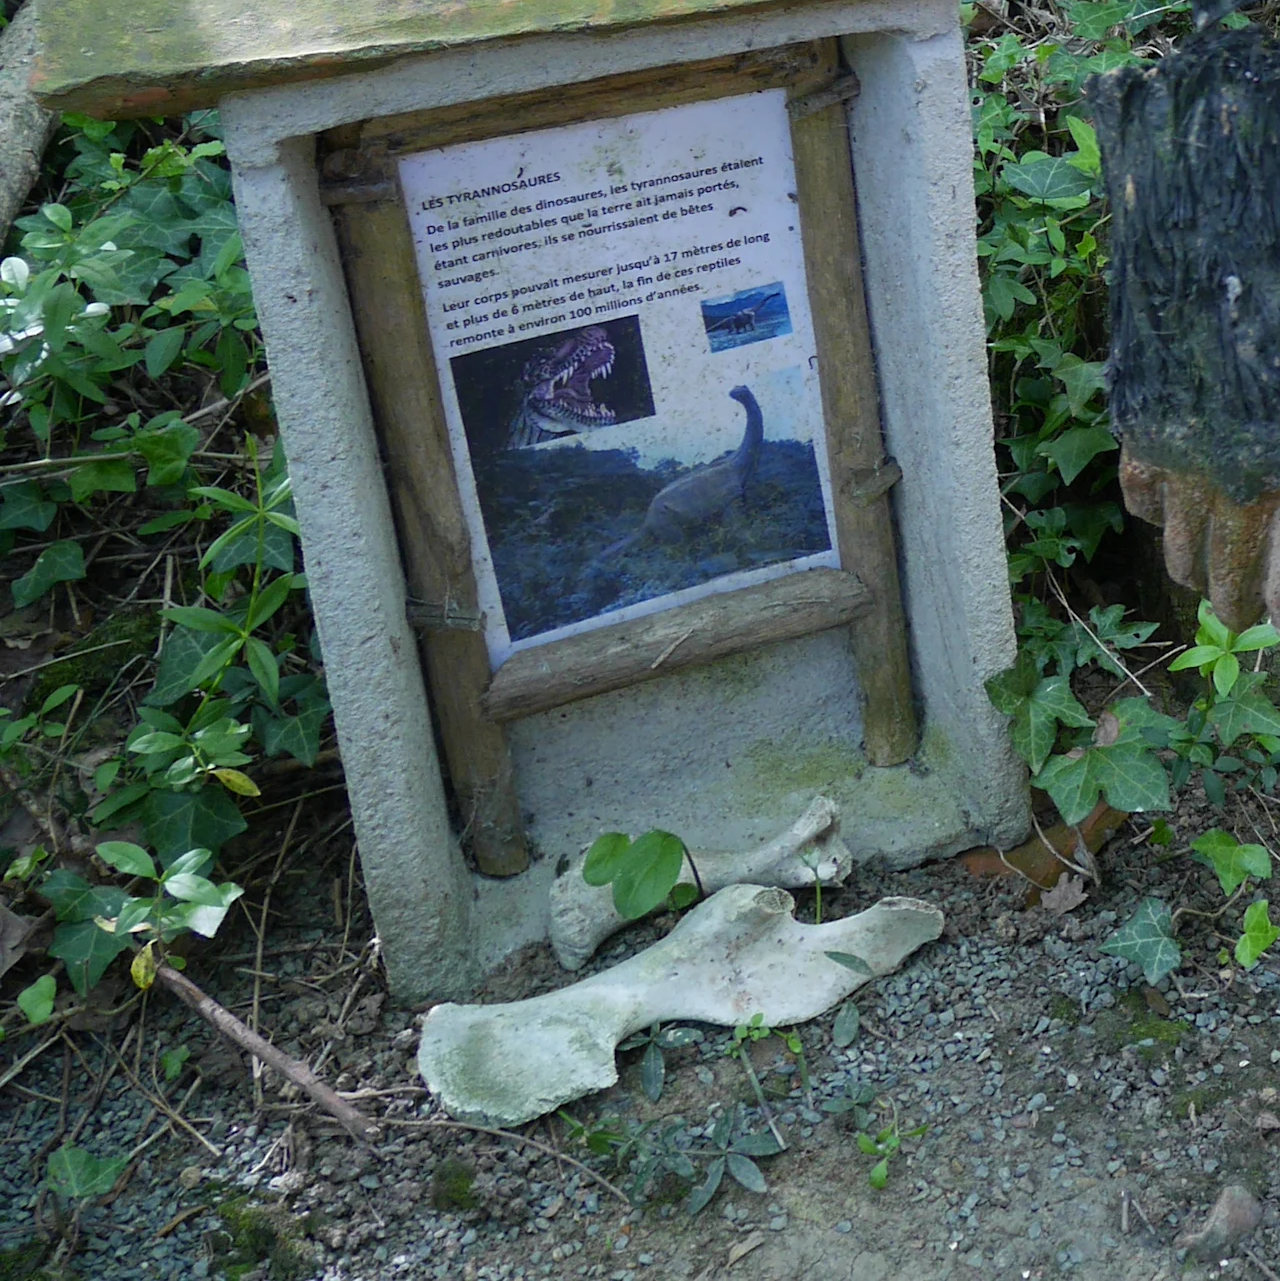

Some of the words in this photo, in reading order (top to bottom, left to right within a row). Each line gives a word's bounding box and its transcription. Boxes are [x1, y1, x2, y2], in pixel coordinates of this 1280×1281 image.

[422, 197, 443, 211] LES
[447, 172, 561, 205] TYRANNOSAURES
[427, 224, 444, 235] De
[448, 220, 459, 231] la
[463, 210, 507, 227] famille
[510, 205, 532, 216] des
[536, 189, 607, 211] dinosaures,
[610, 183, 628, 195] les
[631, 166, 718, 191] tyrannosaures
[721, 156, 764, 172] étaient
[430, 243, 448, 252] les
[452, 236, 478, 250] plus
[482, 217, 557, 241] redoutables
[561, 212, 584, 224] que
[587, 207, 598, 218] la
[602, 201, 632, 215] terre
[636, 196, 651, 208] ait
[654, 188, 694, 206] jamais
[697, 179, 739, 195] portés,
[434, 255, 469, 270] étant
[472, 240, 541, 261] carnivores,
[544, 235, 558, 246] ils
[562, 233, 575, 241] se
[578, 211, 659, 238] nourrissaient
[662, 209, 677, 220] de
[681, 202, 713, 216] bêtes
[443, 301, 470, 312] Leur
[474, 291, 508, 305] corps
[512, 278, 559, 299] pouvait
[562, 265, 613, 285] mesurer
[665, 251, 677, 262] 17
[681, 242, 723, 259] mètres
[727, 238, 741, 249] de
[743, 232, 770, 246] long
[447, 321, 459, 330] et
[463, 313, 489, 328] plus
[492, 308, 508, 320] de
[511, 305, 519, 315] 6
[523, 294, 566, 312] mètres
[569, 290, 585, 301] de
[588, 283, 620, 298] haut,
[622, 279, 634, 289] la
[637, 273, 653, 286] fin
[656, 270, 671, 281] de
[674, 267, 694, 278] ces
[697, 255, 741, 274] reptiles
[450, 326, 504, 347] remonte
[508, 324, 515, 333] à
[519, 312, 566, 331] environ
[569, 306, 592, 320] 100
[596, 295, 643, 313] millions
